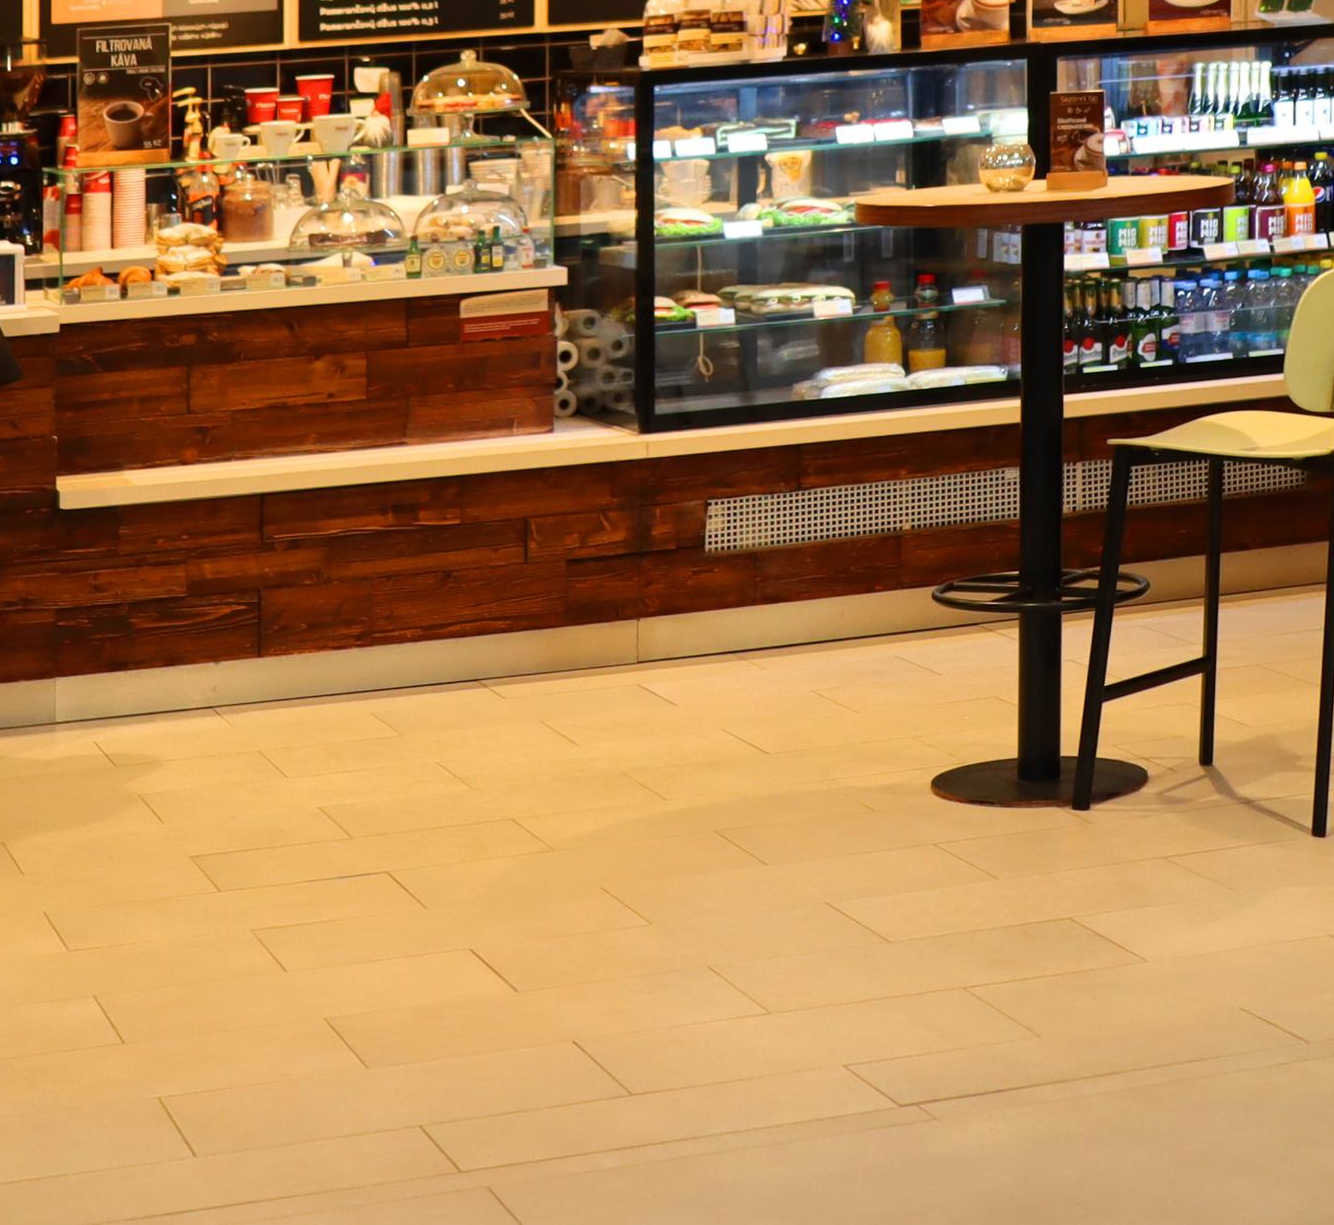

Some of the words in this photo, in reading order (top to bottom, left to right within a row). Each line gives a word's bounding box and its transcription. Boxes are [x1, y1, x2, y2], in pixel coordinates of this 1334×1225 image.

[319, 4, 376, 16] Pomerančový
[376, 2, 397, 13] džus
[319, 20, 376, 32] Pomerančový
[376, 18, 397, 28] džus
[95, 35, 153, 53] FILTROVANÁ
[110, 53, 138, 67] KÁVA
[1200, 218, 1219, 228] MIO
[1295, 213, 1314, 223] MIO
[1118, 228, 1137, 238] MIO
[1200, 228, 1219, 238] MIO
[1295, 223, 1314, 233] MIO
[1118, 238, 1137, 248] MIO
